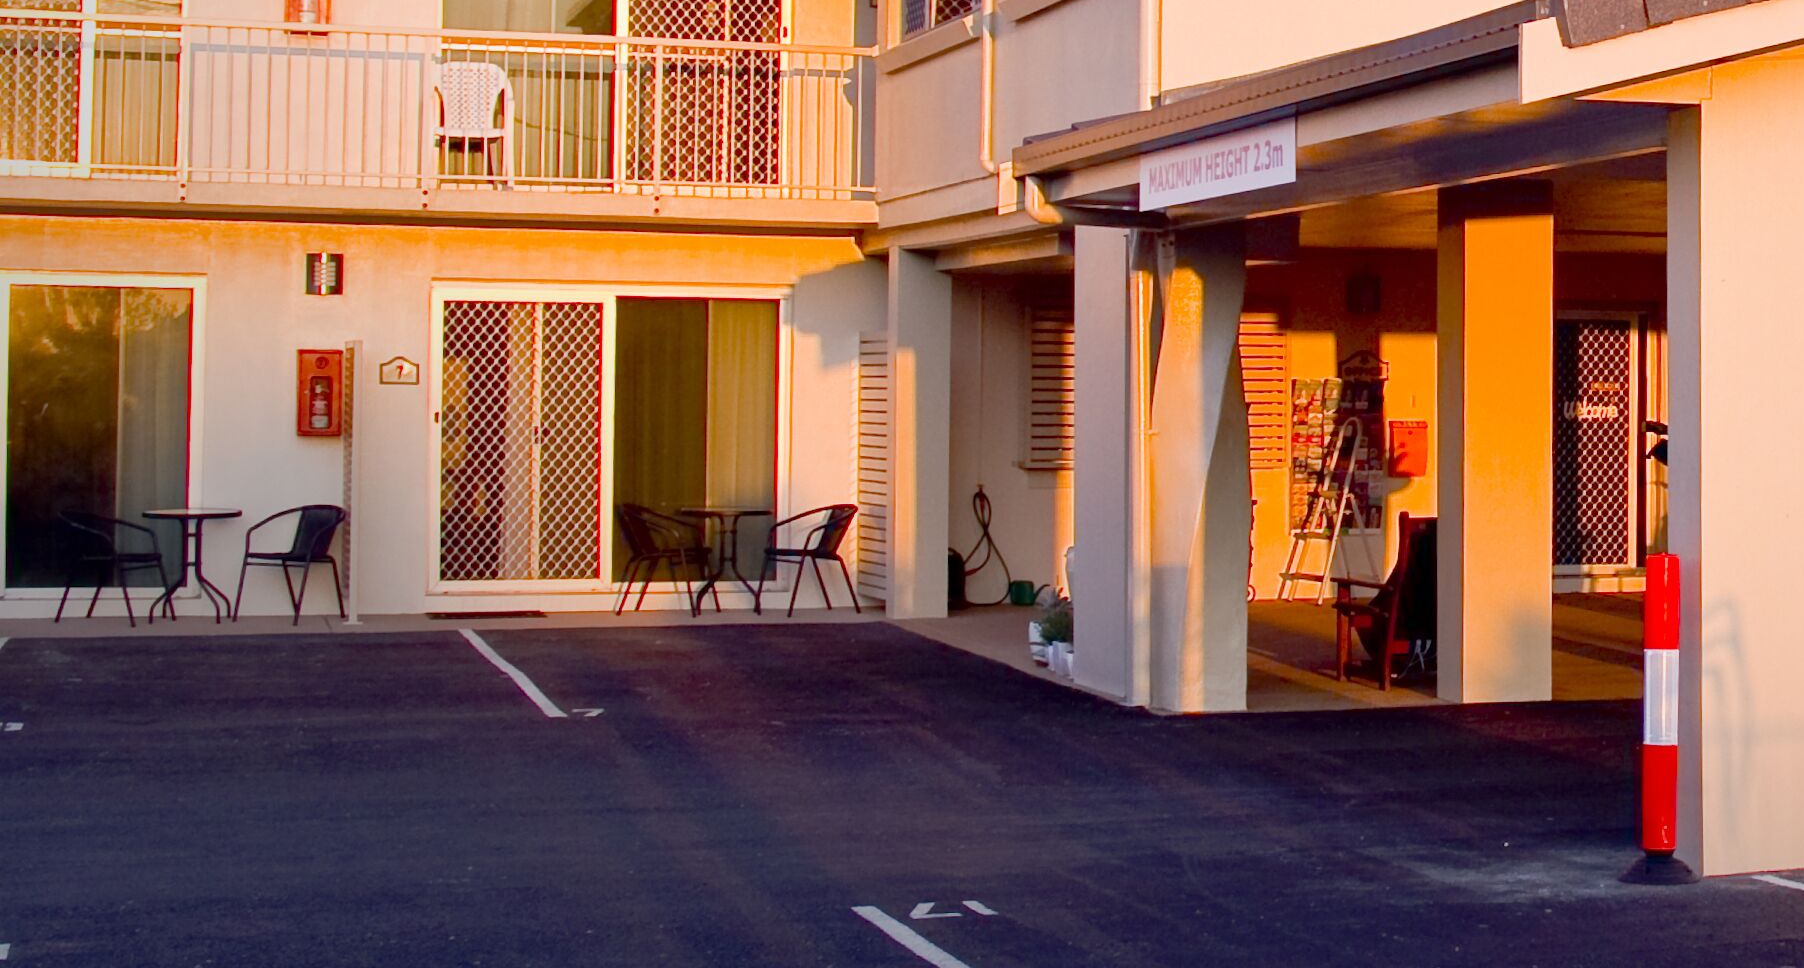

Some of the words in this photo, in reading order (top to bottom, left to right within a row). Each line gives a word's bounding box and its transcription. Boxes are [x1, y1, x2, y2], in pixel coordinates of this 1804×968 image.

[1148, 155, 1202, 194] MAXIMUM
[1205, 144, 1250, 183] HEIGHT
[1253, 140, 1284, 173] 2.3m
[395, 364, 404, 380] 7
